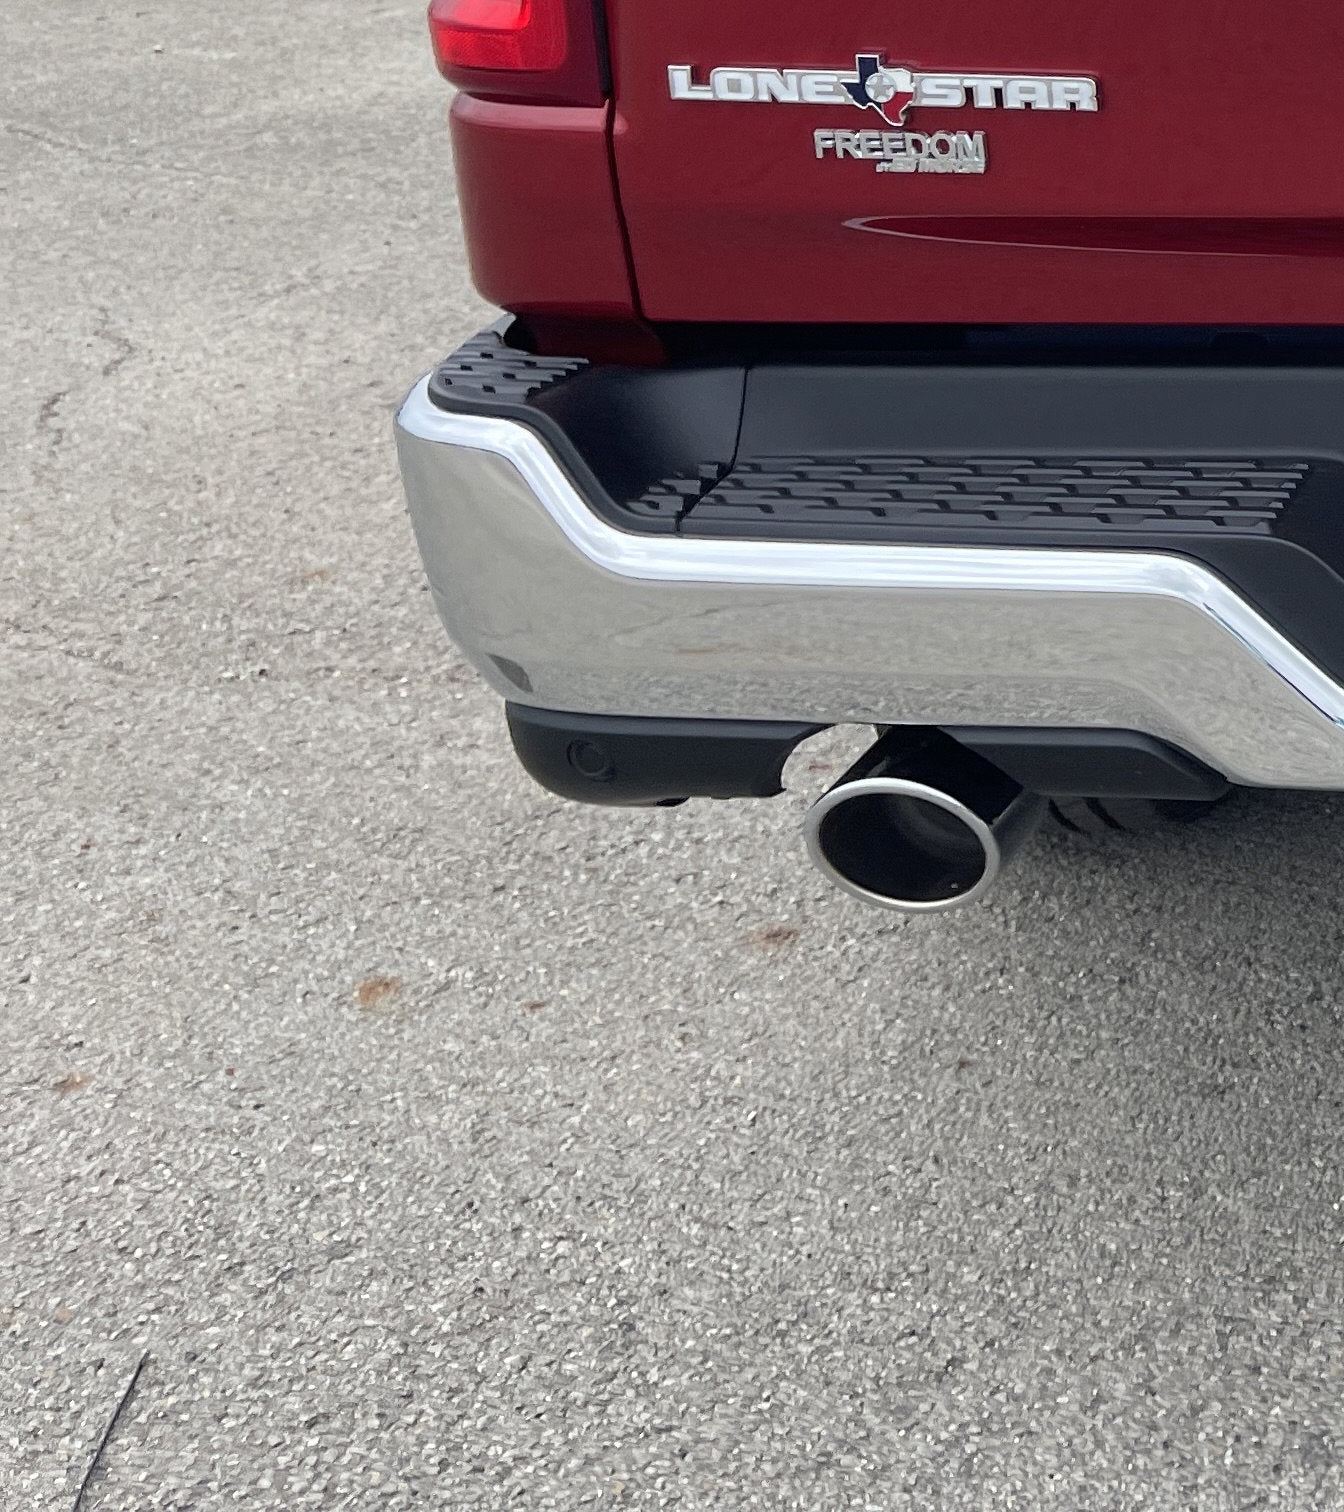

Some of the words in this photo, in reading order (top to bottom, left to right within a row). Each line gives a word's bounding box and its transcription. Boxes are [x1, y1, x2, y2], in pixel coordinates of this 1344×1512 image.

[667, 65, 849, 104] LONE
[917, 74, 1098, 112] STAR
[814, 129, 986, 160] FREEDOM
